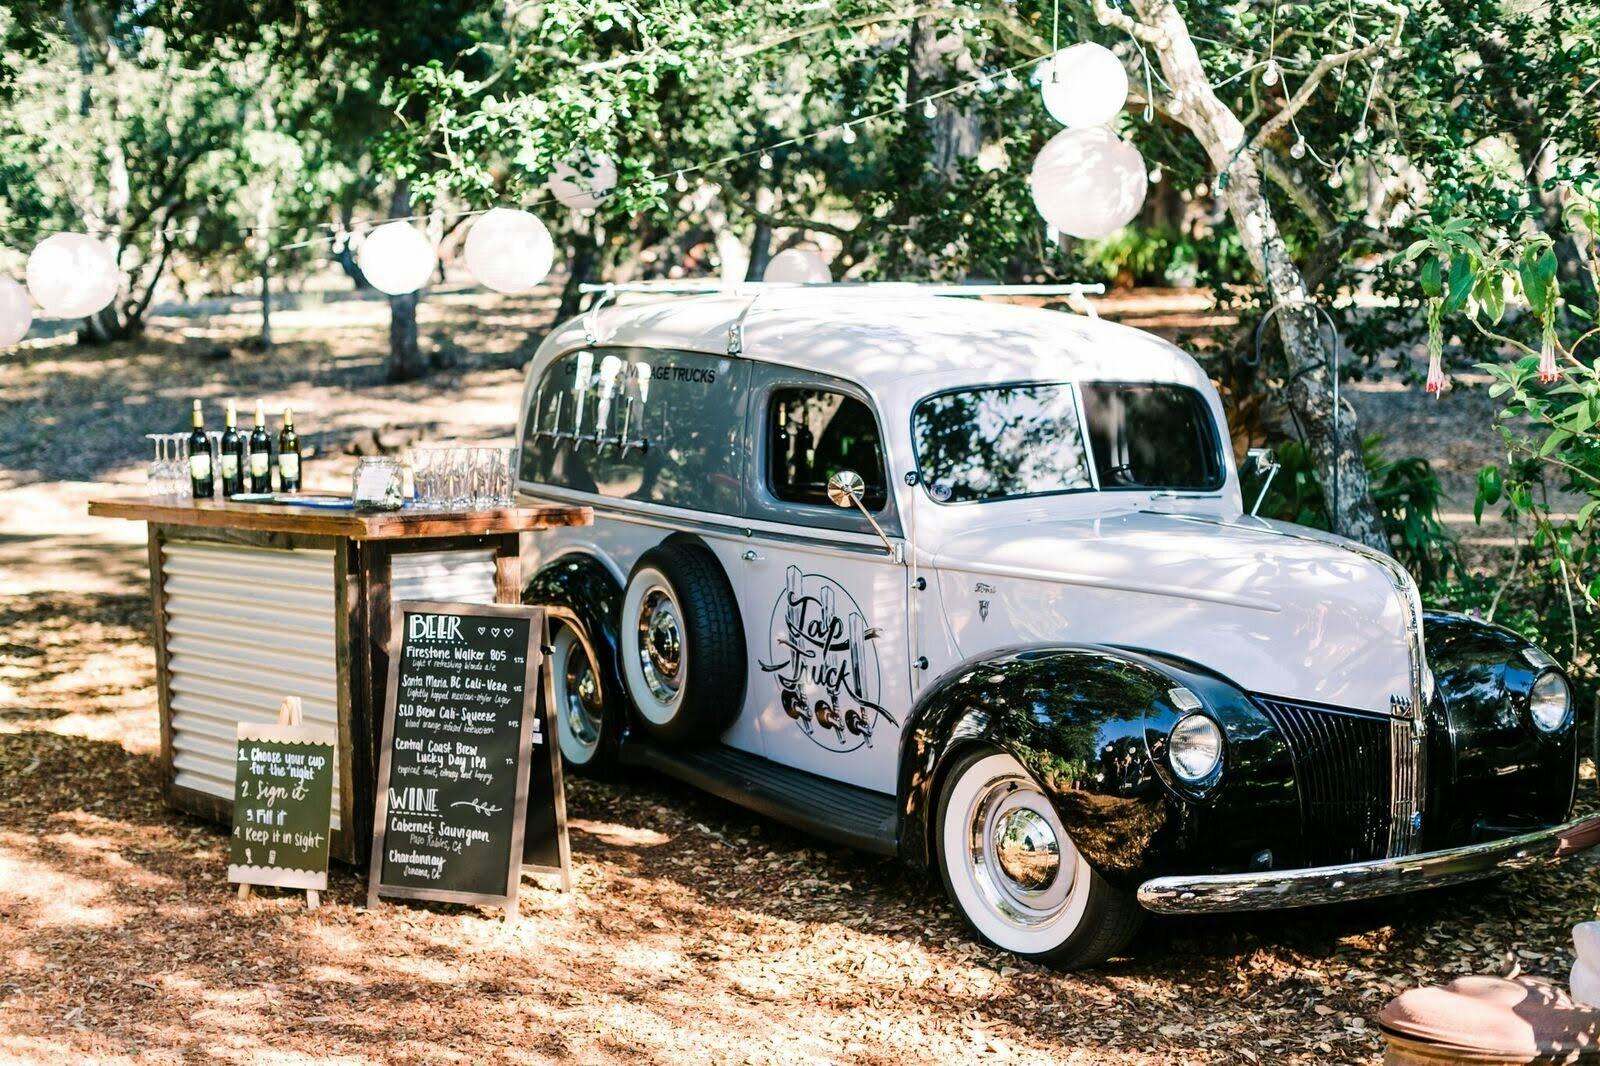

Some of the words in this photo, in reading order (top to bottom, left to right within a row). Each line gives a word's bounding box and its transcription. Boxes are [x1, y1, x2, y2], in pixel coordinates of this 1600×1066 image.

[673, 367, 716, 384] TRUCKS
[408, 614, 464, 640] BEER
[785, 591, 844, 660] Tap
[406, 646, 450, 659] Firestone
[454, 648, 485, 660] Walker
[490, 649, 506, 661] 805
[434, 660, 462, 673] refreshing
[464, 662, 482, 670] blonde
[484, 662, 496, 672] ale
[402, 674, 422, 687] Santa
[426, 674, 448, 688] Maria
[450, 676, 460, 688] BC
[464, 677, 508, 692] Cali-Veza
[430, 689, 450, 702] hopped
[398, 704, 414, 716] SLO
[416, 705, 436, 718] Brew
[439, 706, 496, 726] Cali-Squeeze
[404, 719, 420, 728] blood
[422, 720, 441, 734] orange
[442, 721, 462, 732] infused
[395, 737, 424, 752] Central
[428, 740, 452, 754] Coast
[456, 742, 478, 756] Brew
[250, 748, 282, 764] Choose
[284, 754, 305, 770] your
[308, 756, 326, 770] cup
[416, 752, 444, 768] Lucky
[448, 754, 466, 774] Day
[470, 756, 486, 770] IPA
[250, 762, 265, 775] for
[268, 763, 286, 777] the
[288, 766, 316, 782] night
[398, 765, 420, 776] tropical
[256, 780, 288, 808] Sign
[292, 781, 310, 801] it
[388, 786, 439, 812] WINE
[256, 808, 273, 824] Fill
[276, 810, 288, 826] it
[245, 828, 270, 846] Keep
[272, 828, 281, 843] it
[282, 832, 292, 844] in
[294, 830, 325, 853] sight
[391, 817, 434, 835] Cabernet
[438, 821, 490, 846] Sauvignon
[410, 833, 424, 845] Paso
[452, 840, 462, 855] CA
[389, 849, 447, 872] Chardonnay
[431, 868, 442, 880] CA
